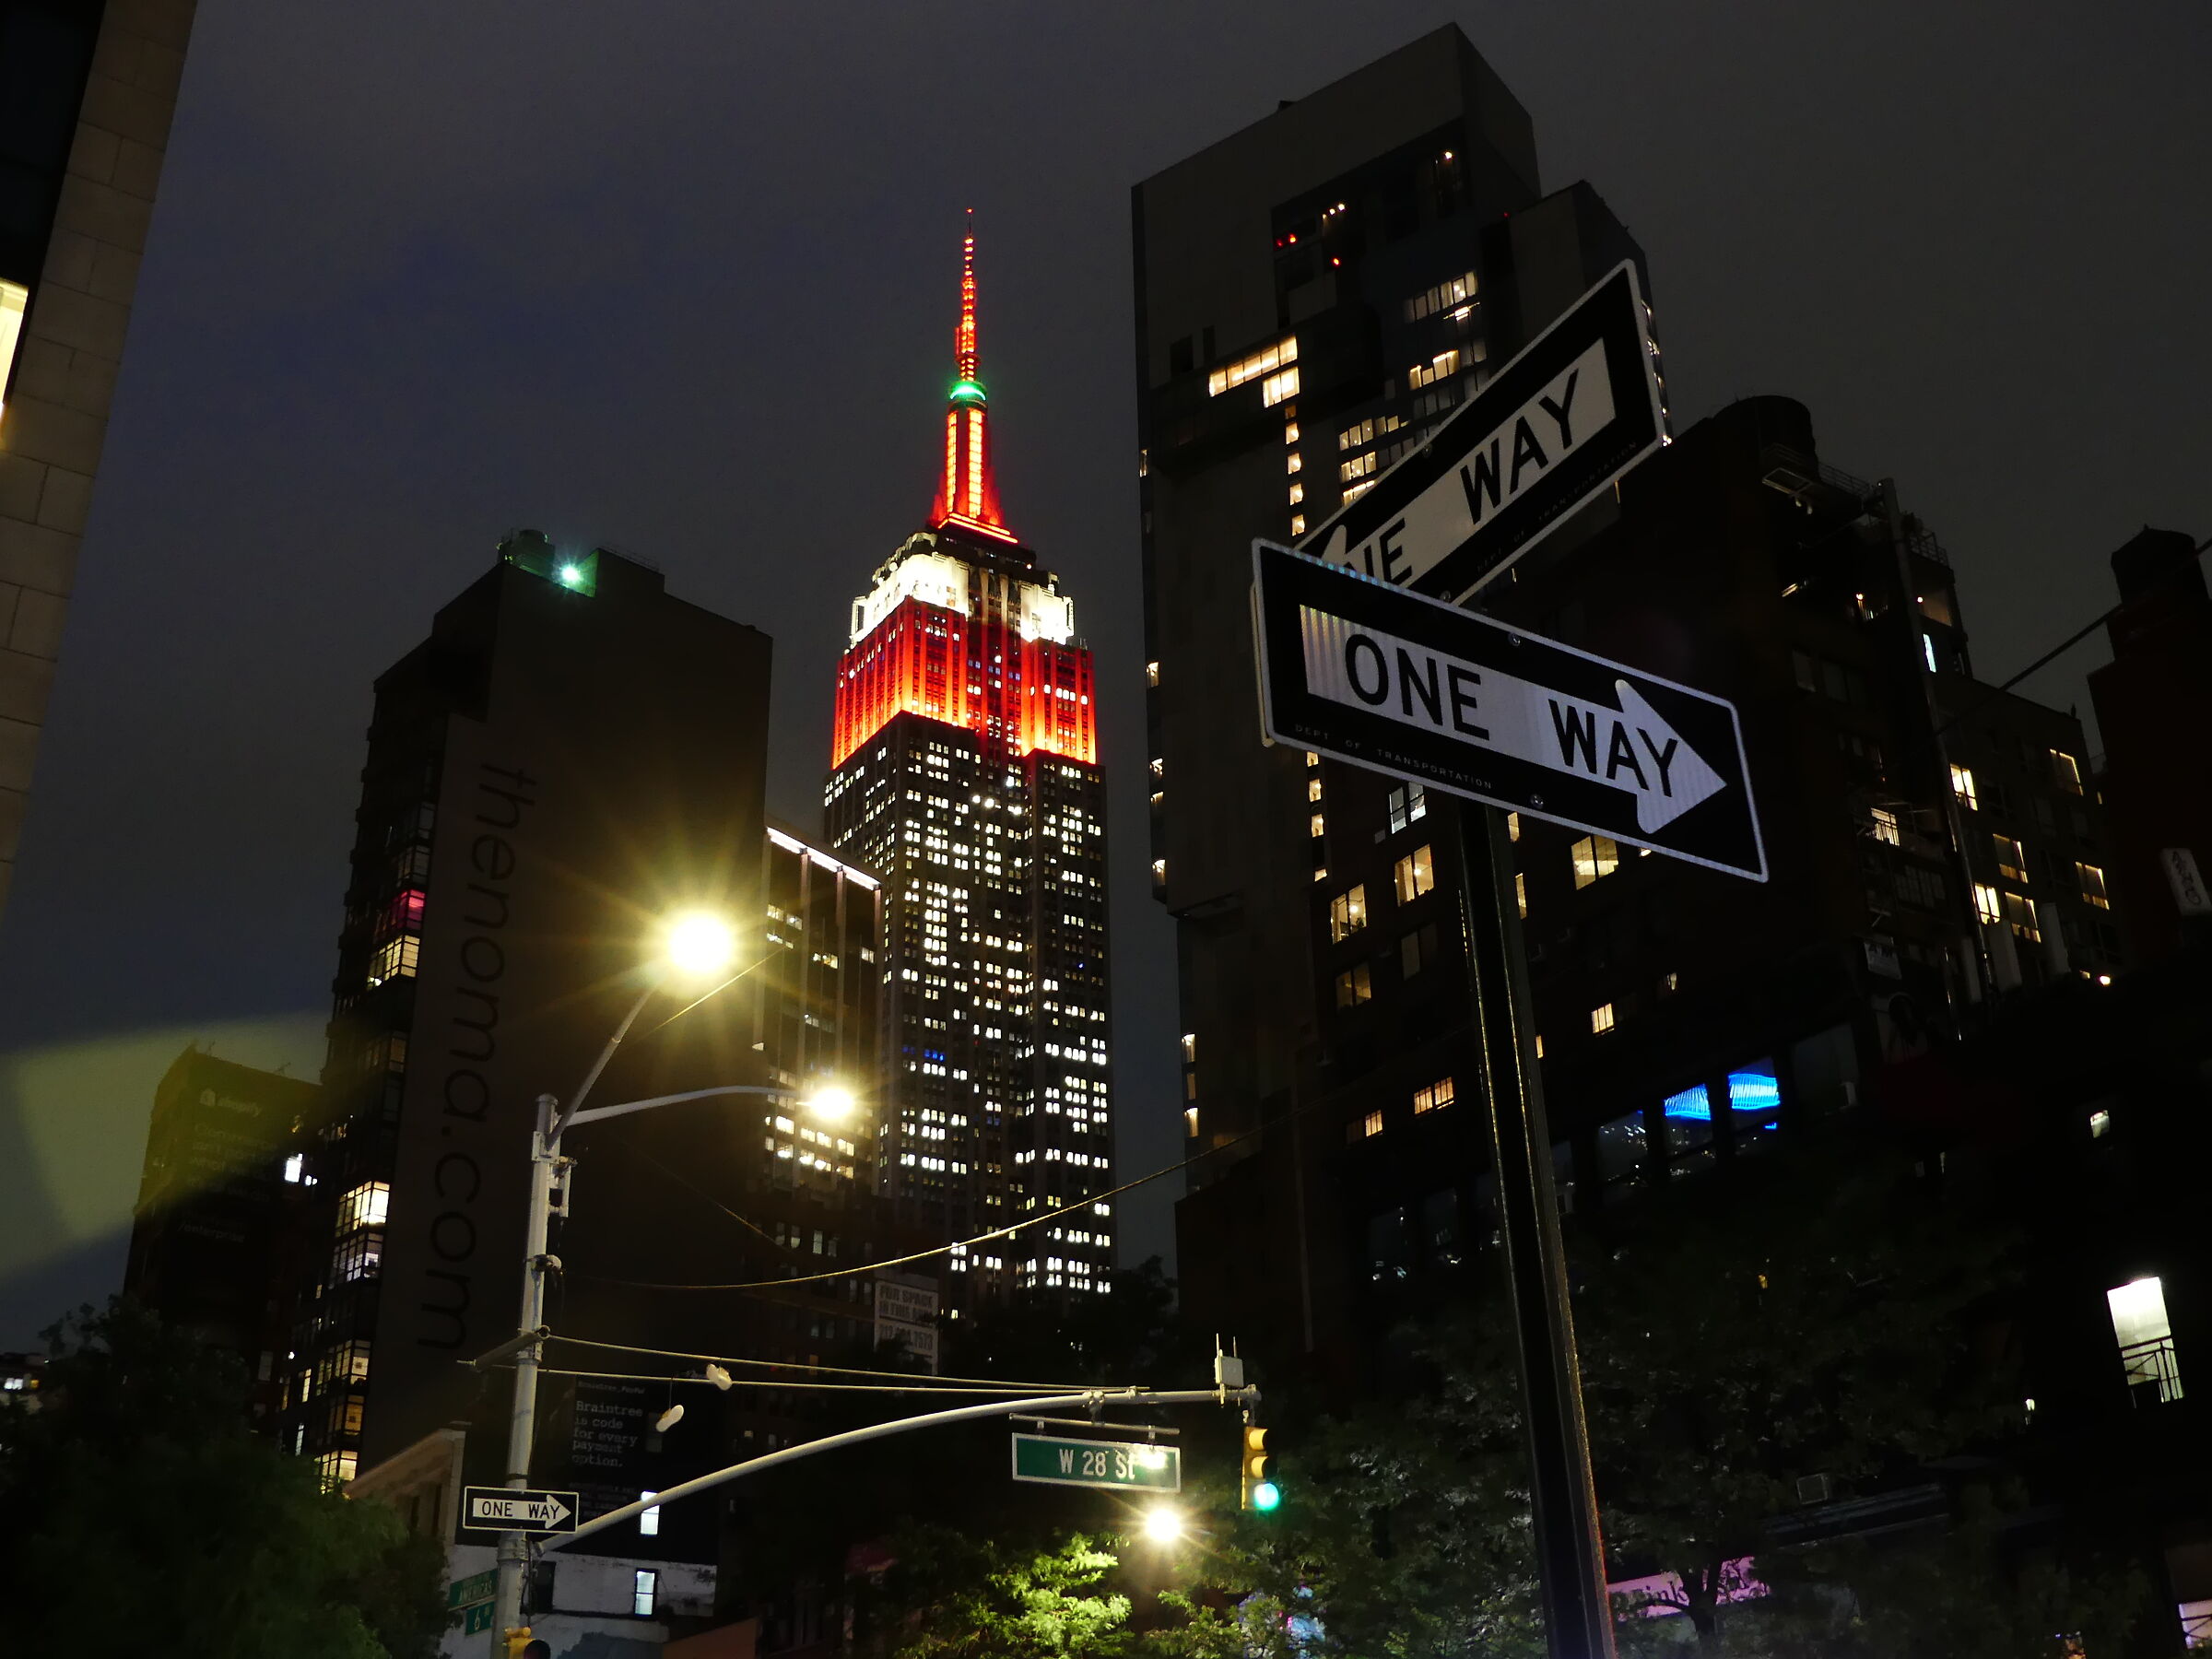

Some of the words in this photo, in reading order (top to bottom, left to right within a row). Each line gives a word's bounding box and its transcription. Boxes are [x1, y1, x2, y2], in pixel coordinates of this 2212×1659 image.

[1460, 369, 1580, 525] WAY
[1344, 632, 1490, 741] ONE
[1547, 698, 1679, 798] WAY
[1295, 724, 1329, 740] DEPT
[1345, 738, 1362, 749] OF
[1375, 747, 1492, 790] TRANSPORTATION
[417, 760, 537, 1351] thenoma.com
[575, 1400, 644, 1418] Braintree
[574, 1416, 588, 1427] is
[591, 1417, 624, 1430] code
[571, 1439, 624, 1454] payment
[573, 1427, 595, 1441] for
[597, 1431, 639, 1448] every
[1059, 1448, 1075, 1475] W
[1082, 1450, 1107, 1477] 28
[481, 1500, 513, 1518] ONE
[528, 1503, 560, 1520] WAY
